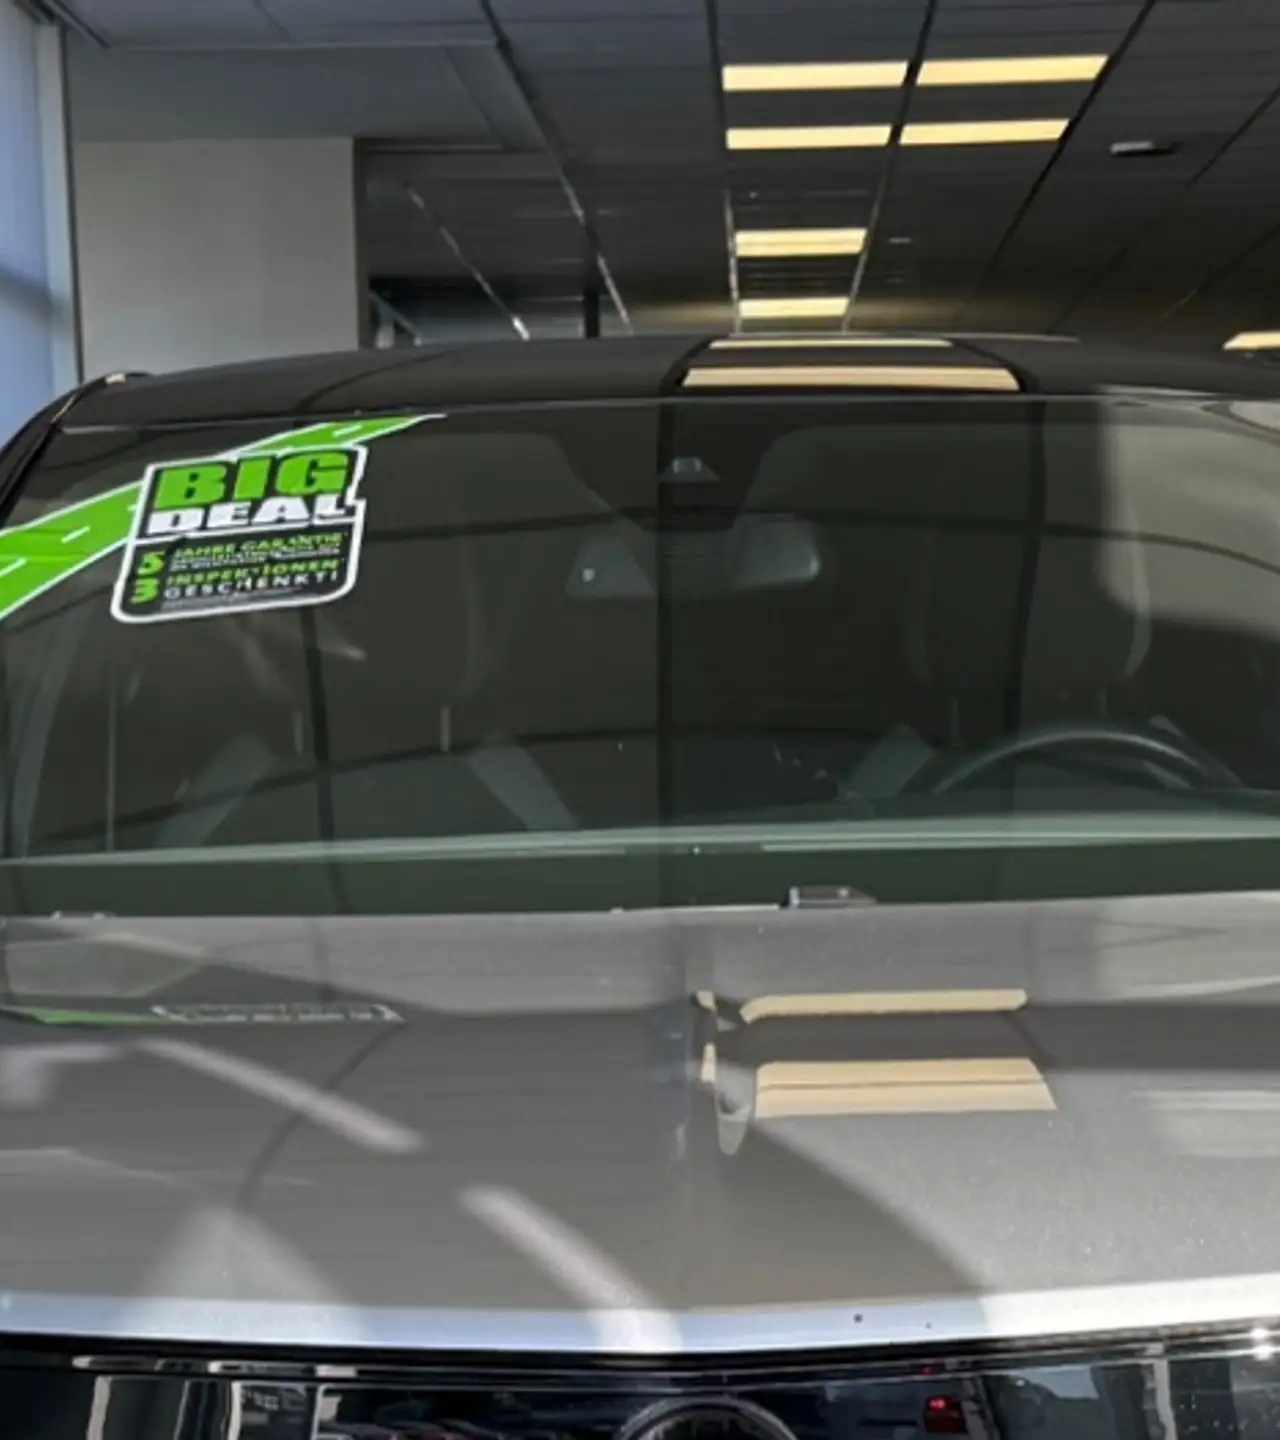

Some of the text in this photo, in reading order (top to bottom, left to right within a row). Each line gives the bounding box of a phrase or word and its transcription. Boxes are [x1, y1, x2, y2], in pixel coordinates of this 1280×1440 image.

[154, 451, 349, 510] BIG
[147, 494, 346, 535] DEAL
[174, 543, 236, 560] JAHRE
[240, 532, 342, 553] GARANTIE
[137, 551, 165, 575] 5
[167, 558, 339, 587] INSPEKTIONEN
[132, 578, 159, 603] 3
